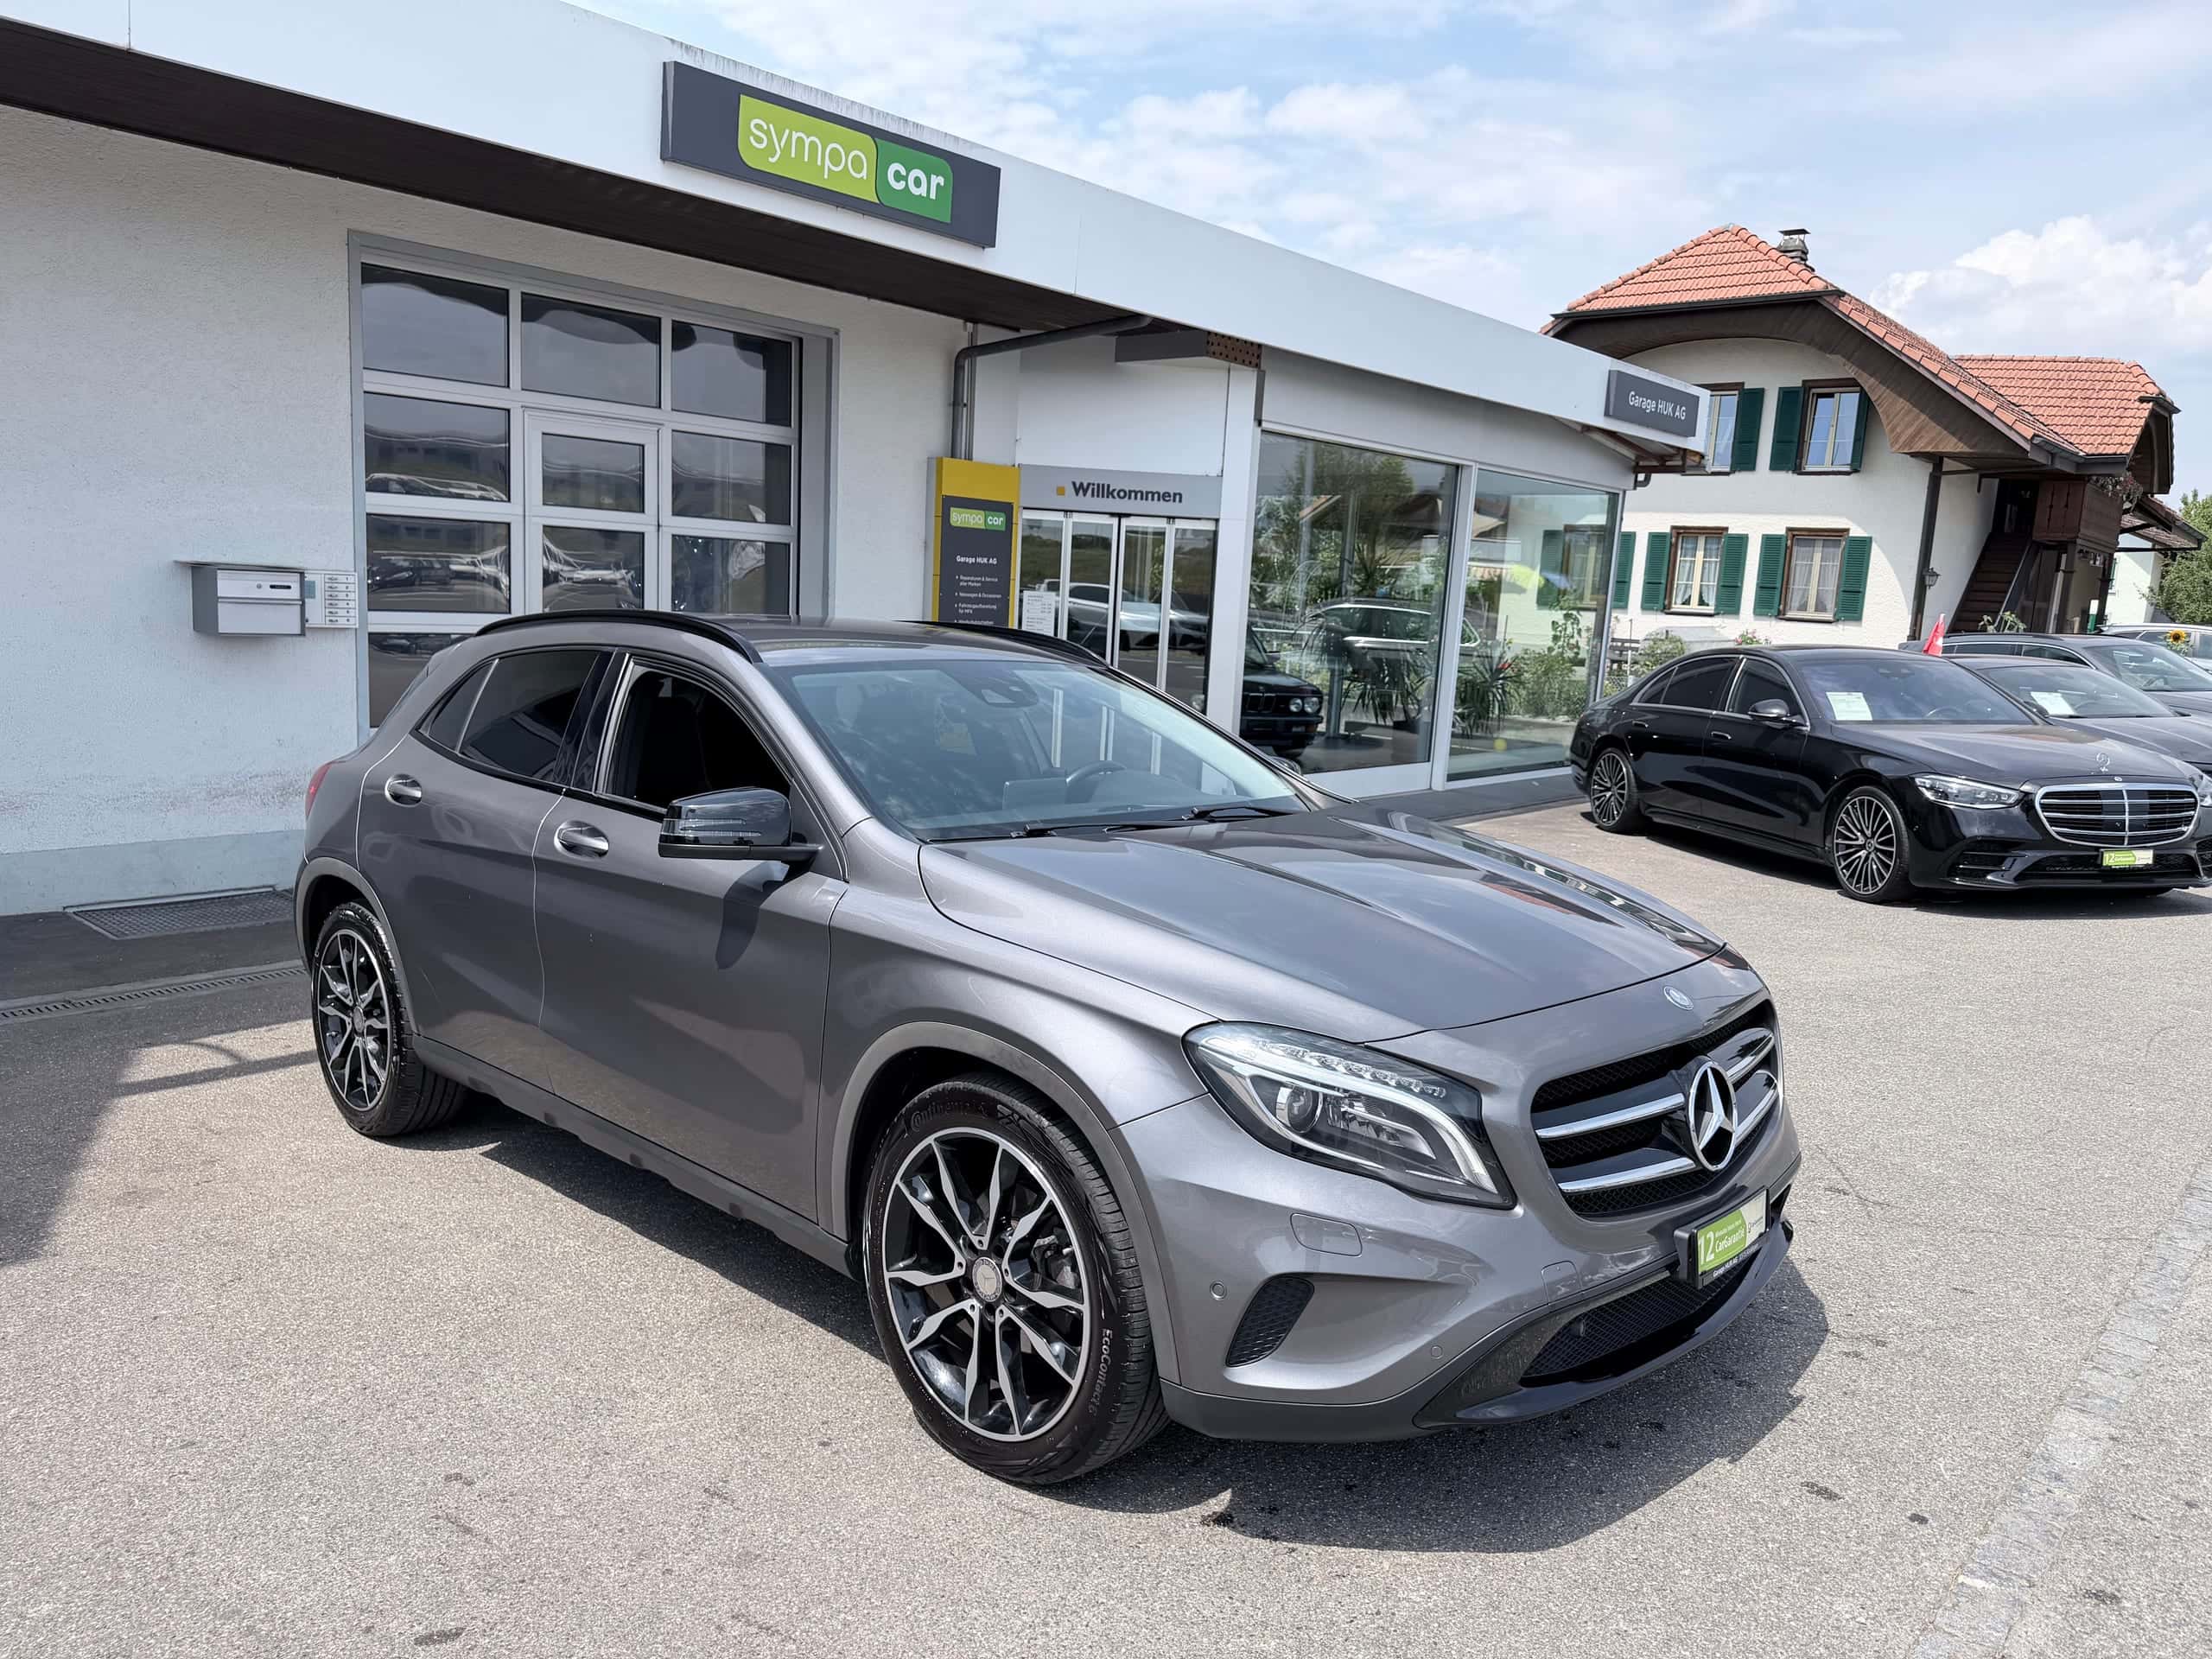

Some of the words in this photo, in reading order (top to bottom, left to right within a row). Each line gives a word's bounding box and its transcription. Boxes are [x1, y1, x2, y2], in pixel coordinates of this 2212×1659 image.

[748, 118, 868, 180] sympa
[887, 162, 944, 200] car
[1628, 391, 1656, 413] Garage
[1657, 398, 1675, 416] HUK
[1675, 404, 1687, 421] AG
[1071, 480, 1184, 504] Willkommen
[951, 511, 983, 527] sympa
[987, 515, 1004, 526] car
[956, 555, 976, 564] Garage
[1698, 1230, 1716, 1265] 12
